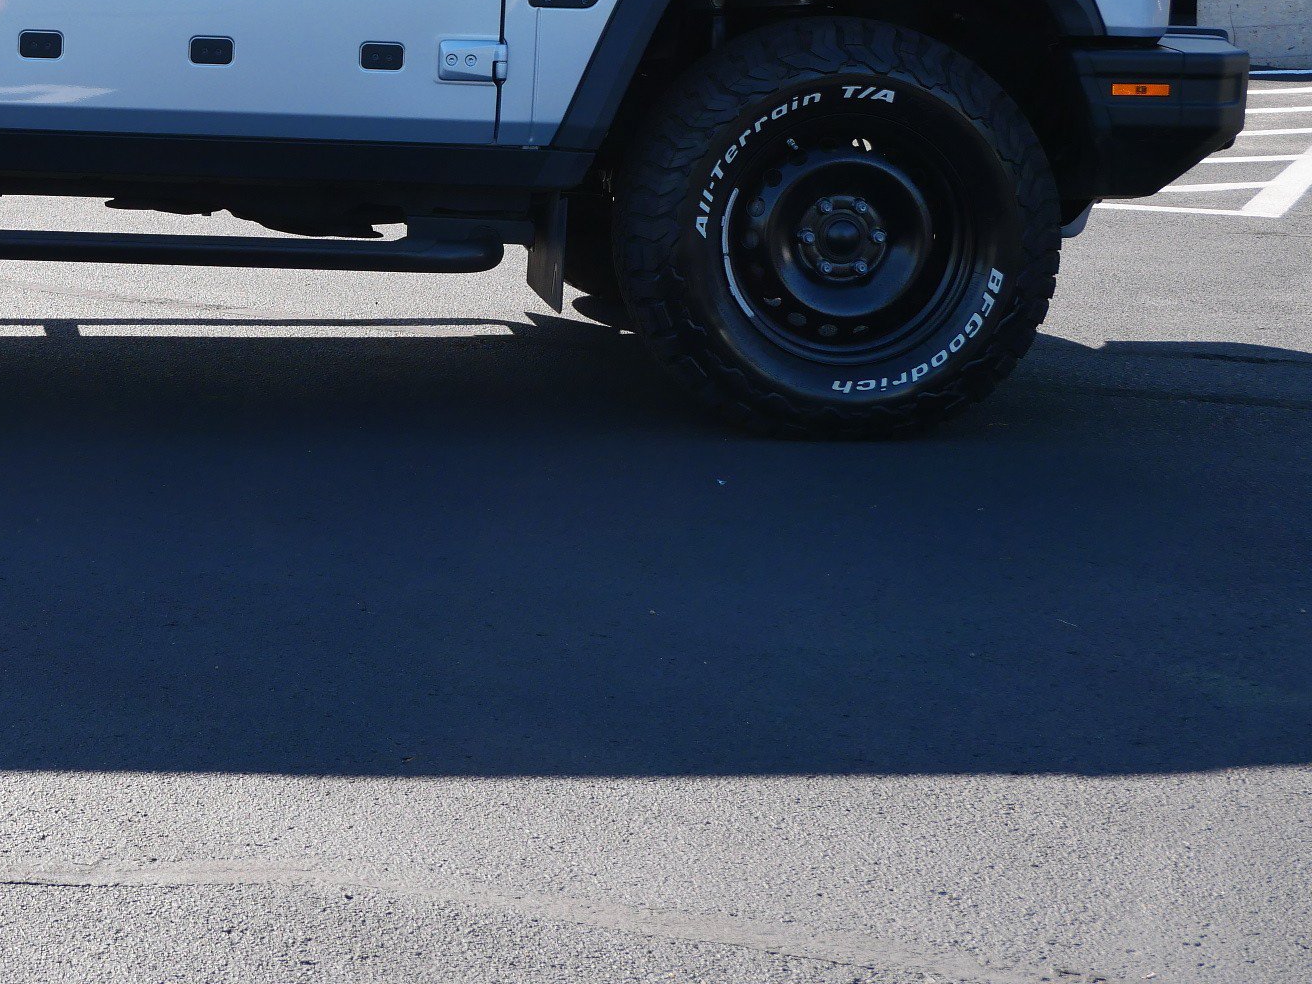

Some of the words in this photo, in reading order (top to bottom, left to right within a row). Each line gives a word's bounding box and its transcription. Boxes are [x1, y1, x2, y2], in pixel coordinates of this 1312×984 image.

[694, 91, 822, 239] All-Terrain
[841, 85, 896, 104] T/A
[831, 267, 1005, 394] BFGoodrich
